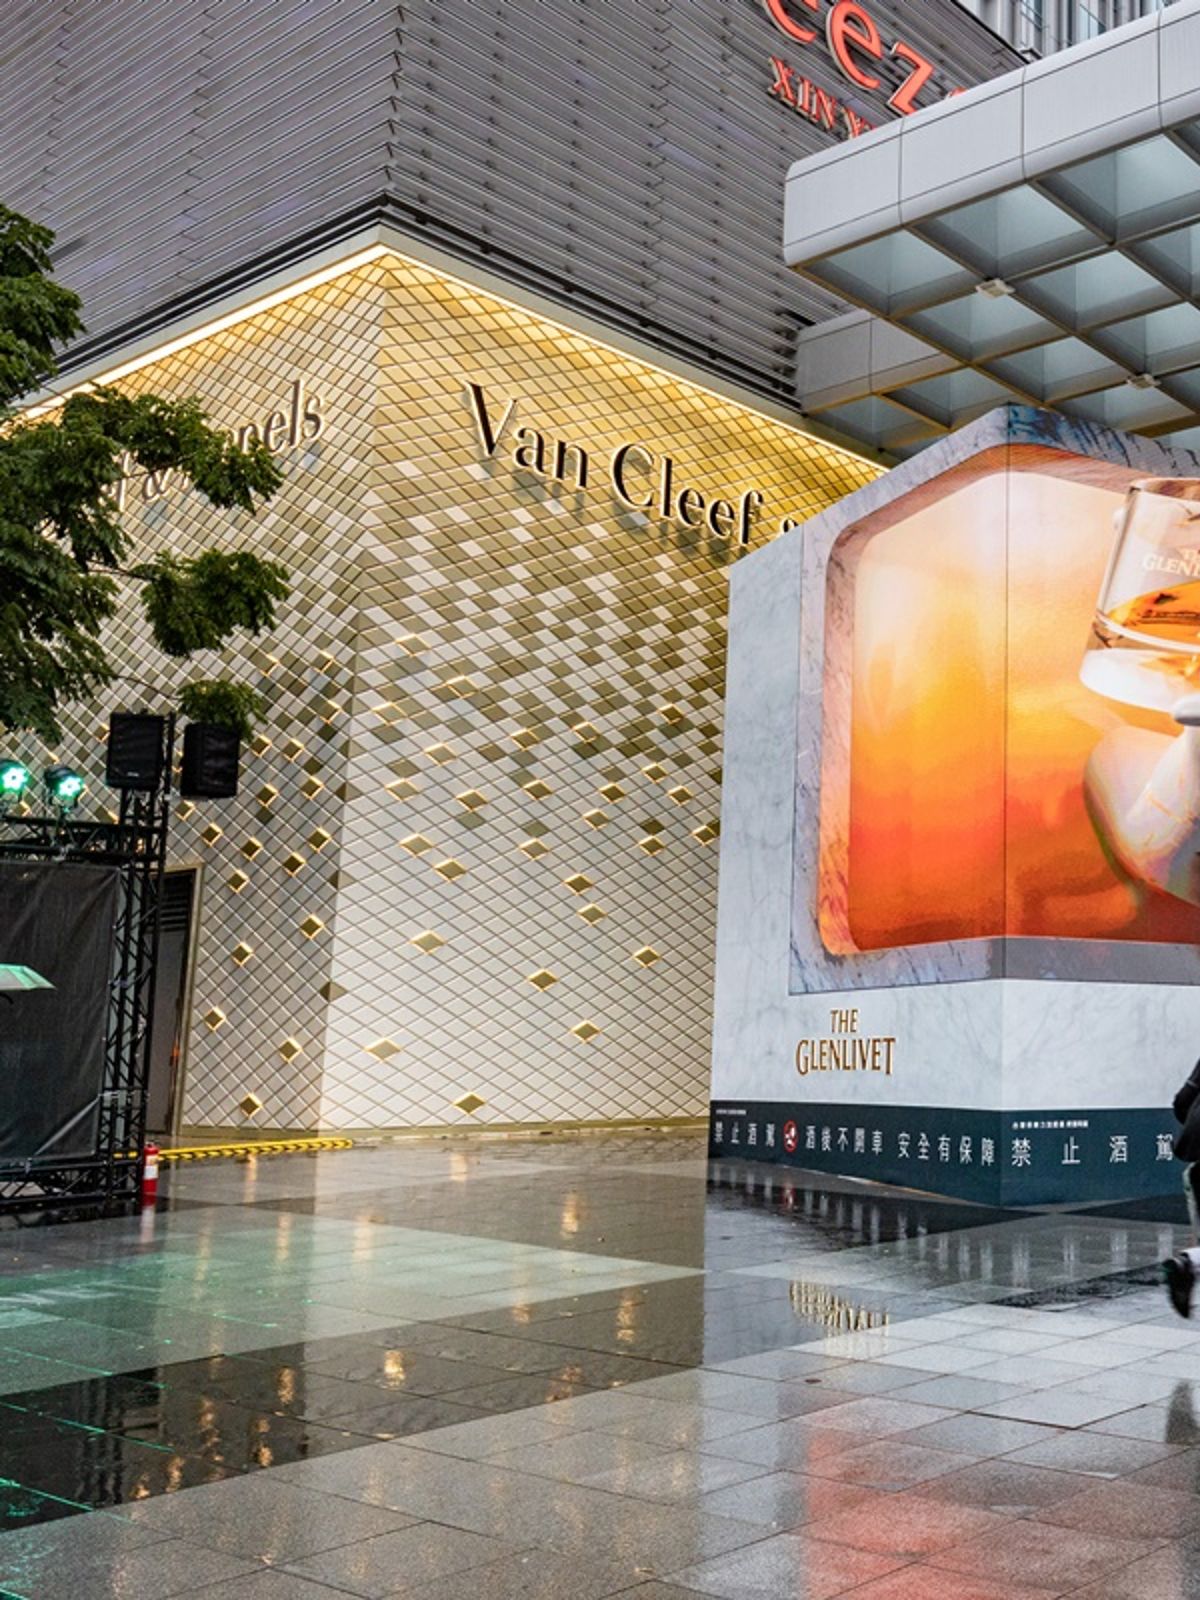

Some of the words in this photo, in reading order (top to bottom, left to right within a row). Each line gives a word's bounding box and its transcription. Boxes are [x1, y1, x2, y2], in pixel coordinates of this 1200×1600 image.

[465, 380, 589, 488] Van
[611, 443, 764, 545] Cleef
[830, 1009, 859, 1033] THE
[795, 1037, 897, 1076] GLENLIVET
[1010, 1134, 1174, 1168] 禁止酒駕
